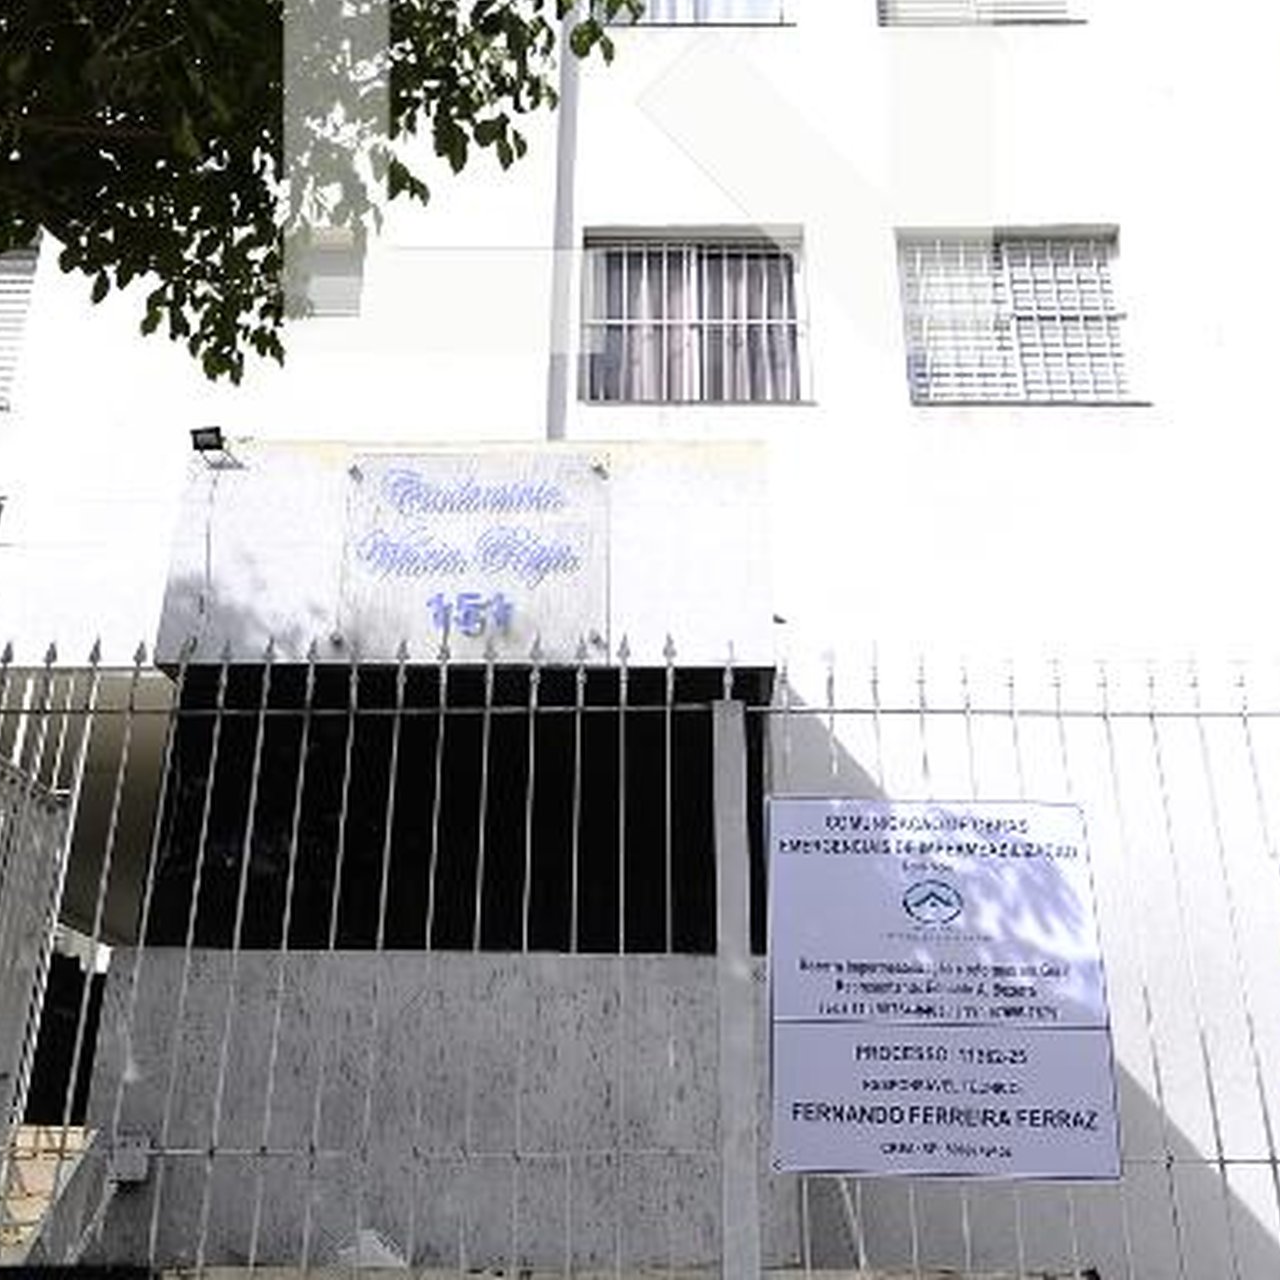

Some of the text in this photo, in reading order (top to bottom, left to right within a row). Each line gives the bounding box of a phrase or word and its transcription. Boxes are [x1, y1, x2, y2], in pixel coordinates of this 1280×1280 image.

[426, 591, 514, 639] 151
[791, 1102, 1100, 1131] FERNANDO FERREIRA FERRAZ
